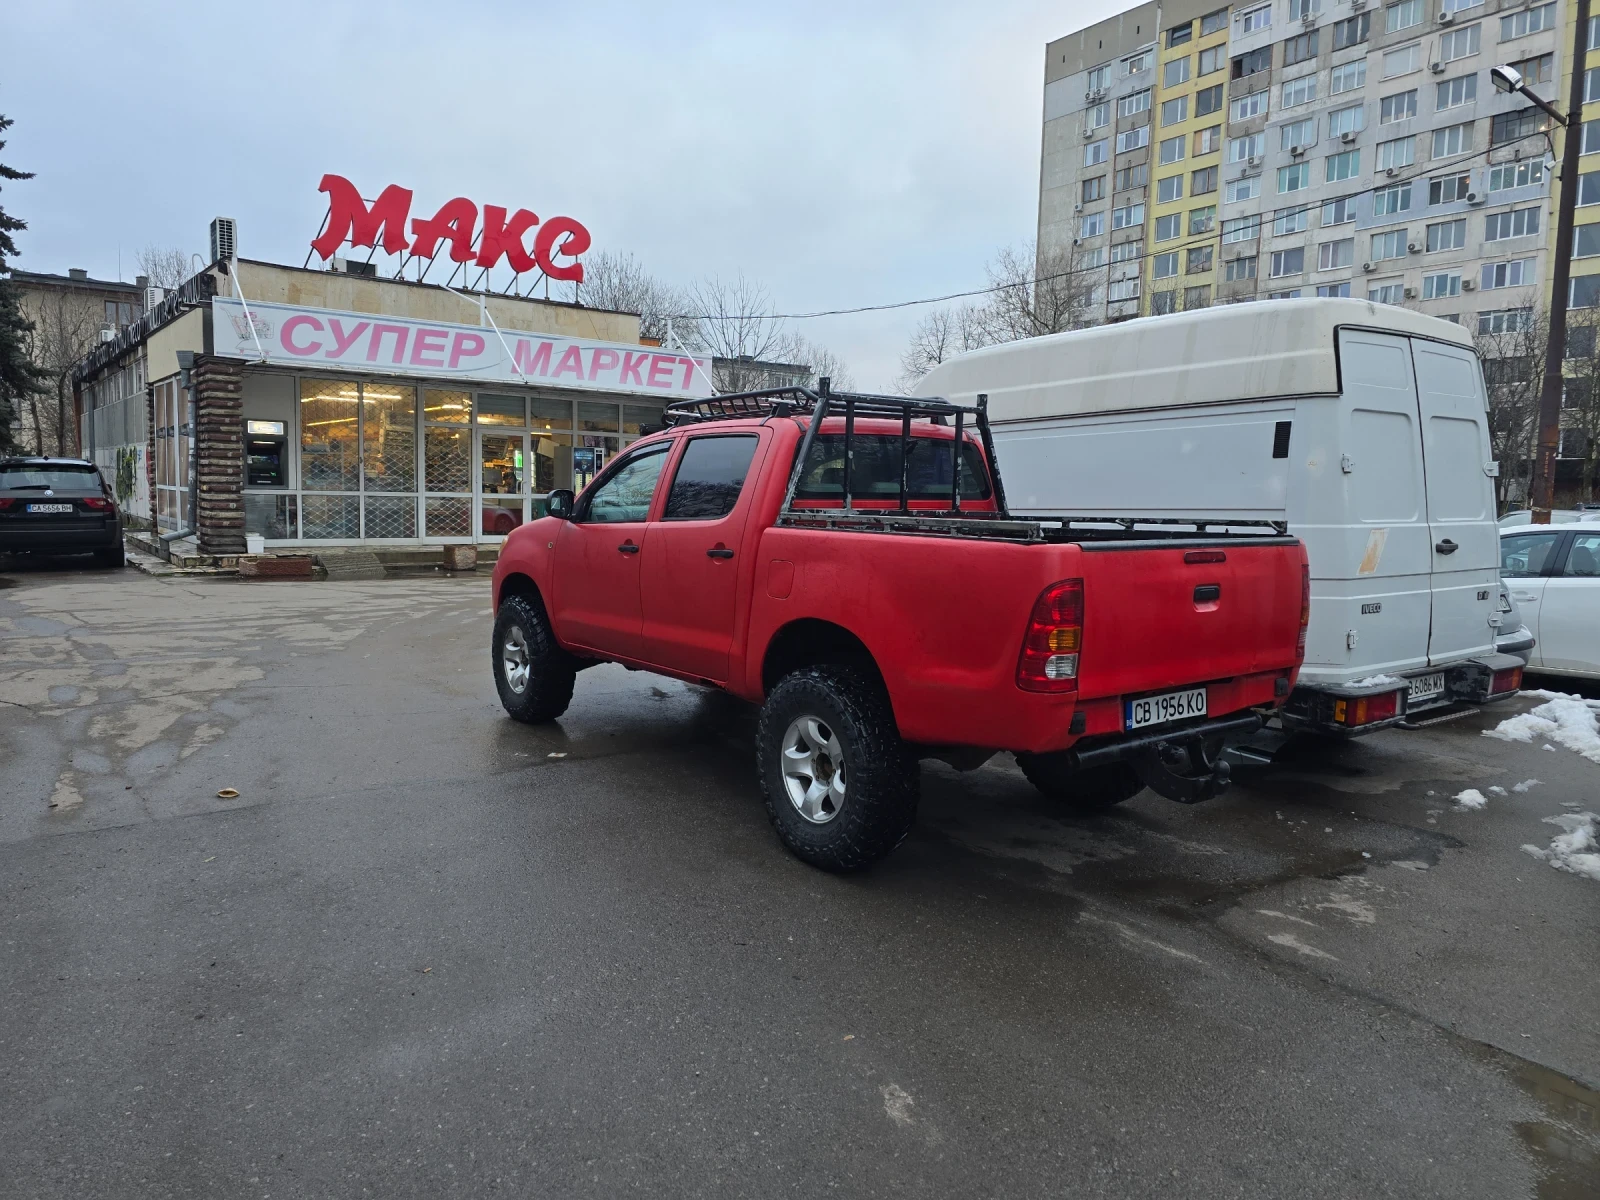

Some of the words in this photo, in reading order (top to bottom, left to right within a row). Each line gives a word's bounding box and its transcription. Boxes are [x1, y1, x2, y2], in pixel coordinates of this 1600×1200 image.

[280, 315, 486, 369] СУПЕР
[511, 338, 704, 390] МАРКЕТ
[1362, 603, 1382, 614] IVECO
[1415, 677, 1432, 694] 6086
[1135, 702, 1151, 724] CB
[1155, 695, 1185, 719] 1956
[1187, 692, 1204, 714] KO
